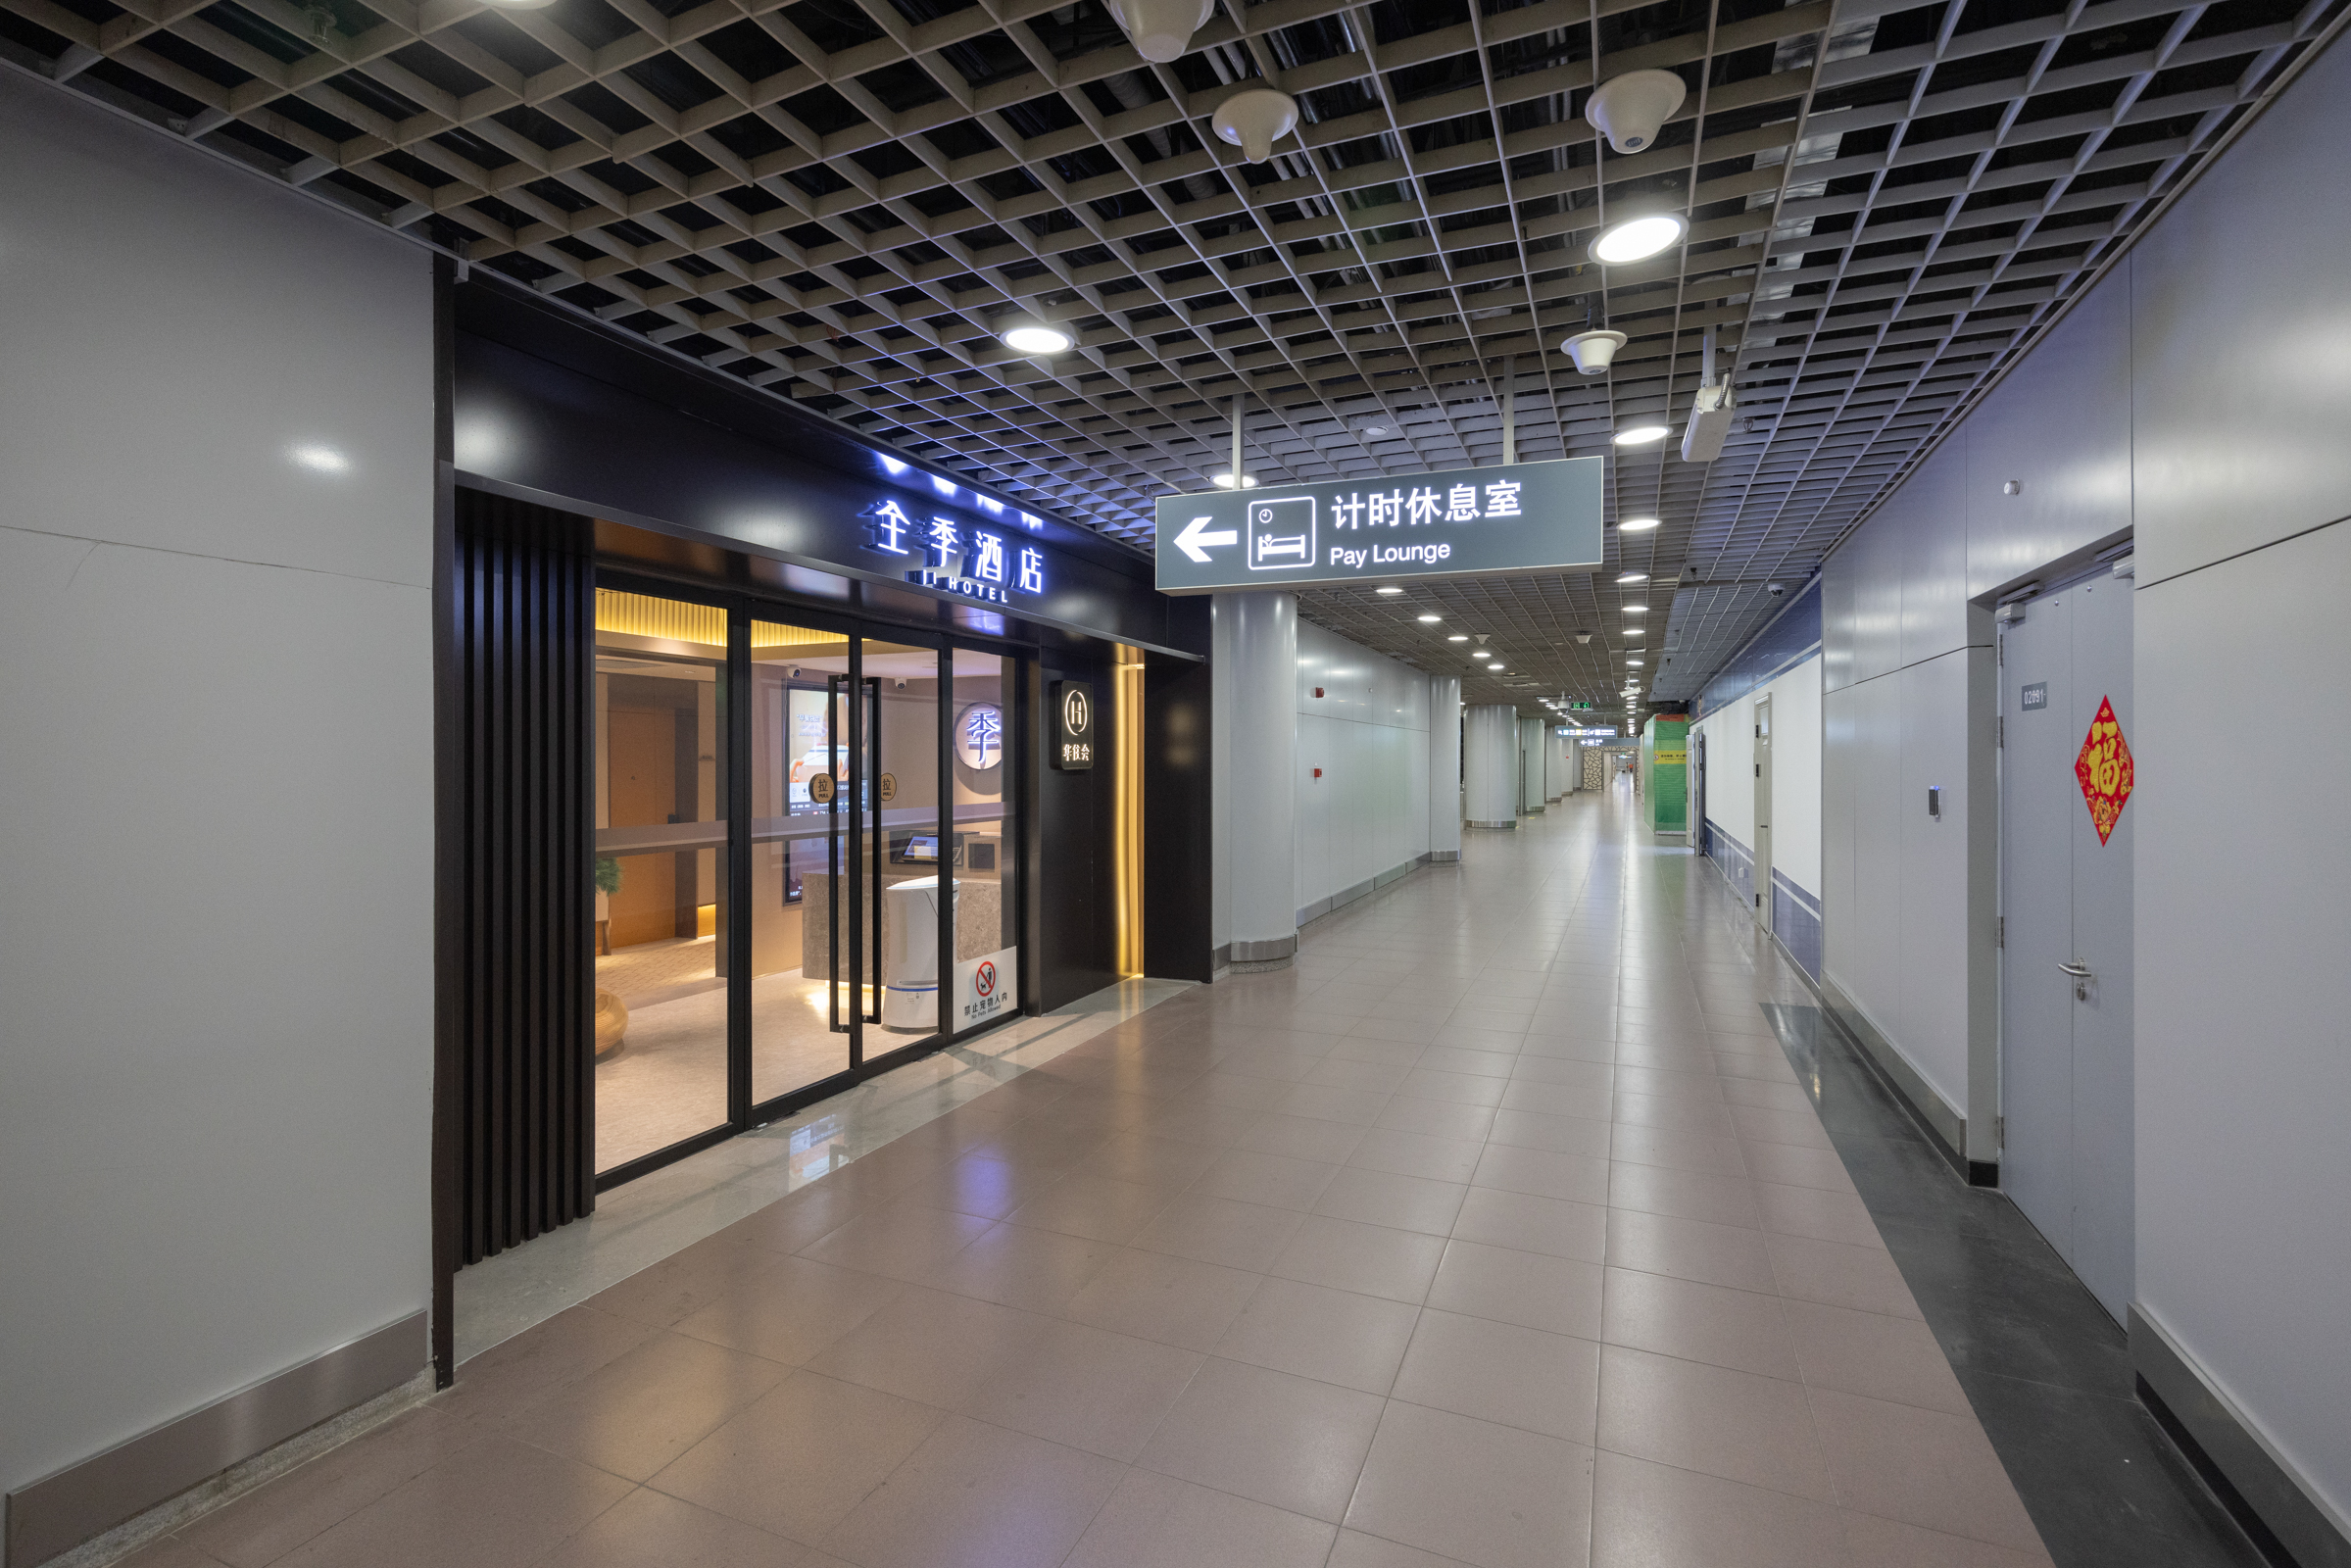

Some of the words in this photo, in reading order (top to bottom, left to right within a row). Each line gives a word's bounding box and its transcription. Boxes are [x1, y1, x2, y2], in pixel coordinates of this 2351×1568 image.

[1331, 479, 1522, 530] 计时休息室
[875, 500, 1044, 594] 全季酒店
[1330, 546, 1368, 569] Pay
[1373, 540, 1451, 565] Lounge
[949, 576, 1008, 604] HOTEL
[966, 710, 1001, 763] 季
[2087, 720, 2121, 798] 福
[818, 779, 829, 792] 拉
[882, 778, 892, 791] 拉
[987, 1004, 1001, 1013] Allowed
